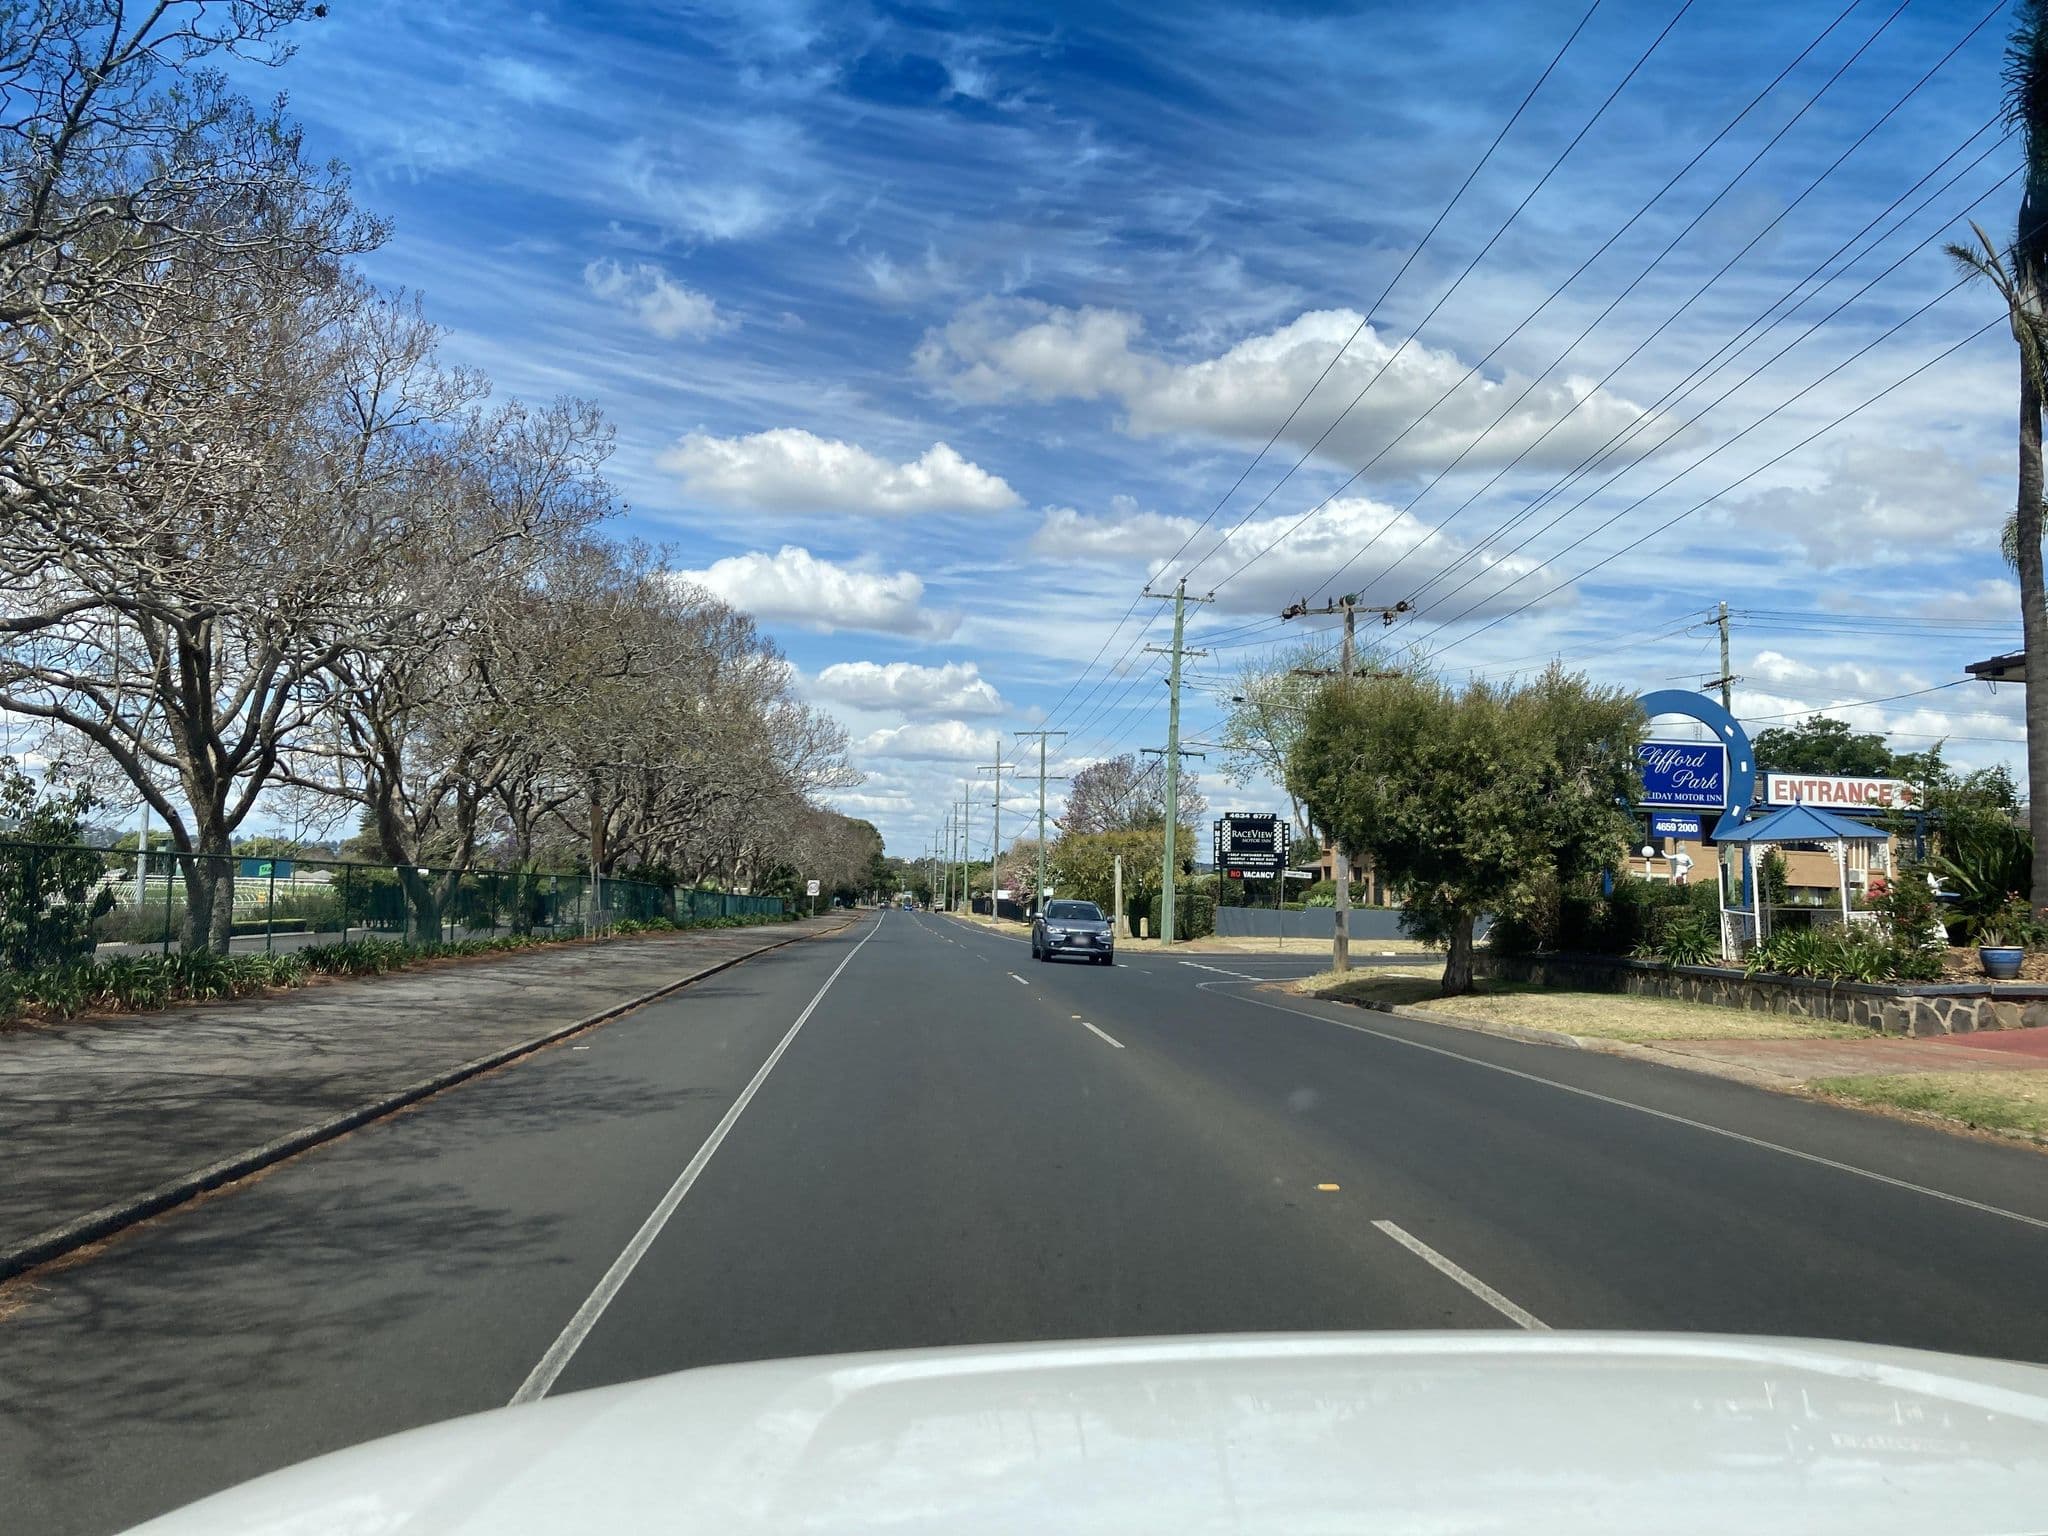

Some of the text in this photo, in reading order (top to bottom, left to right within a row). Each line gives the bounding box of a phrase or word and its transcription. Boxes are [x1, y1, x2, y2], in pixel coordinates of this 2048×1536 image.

[1638, 745, 1707, 774] Clifford
[1671, 769, 1719, 790] Park
[1674, 793, 1705, 802] MOTOR
[1707, 794, 1722, 802] INN
[1774, 780, 1893, 804] ENTRANCE
[1656, 822, 1698, 833] 4659 2000
[1243, 871, 1275, 879] VACANCY
